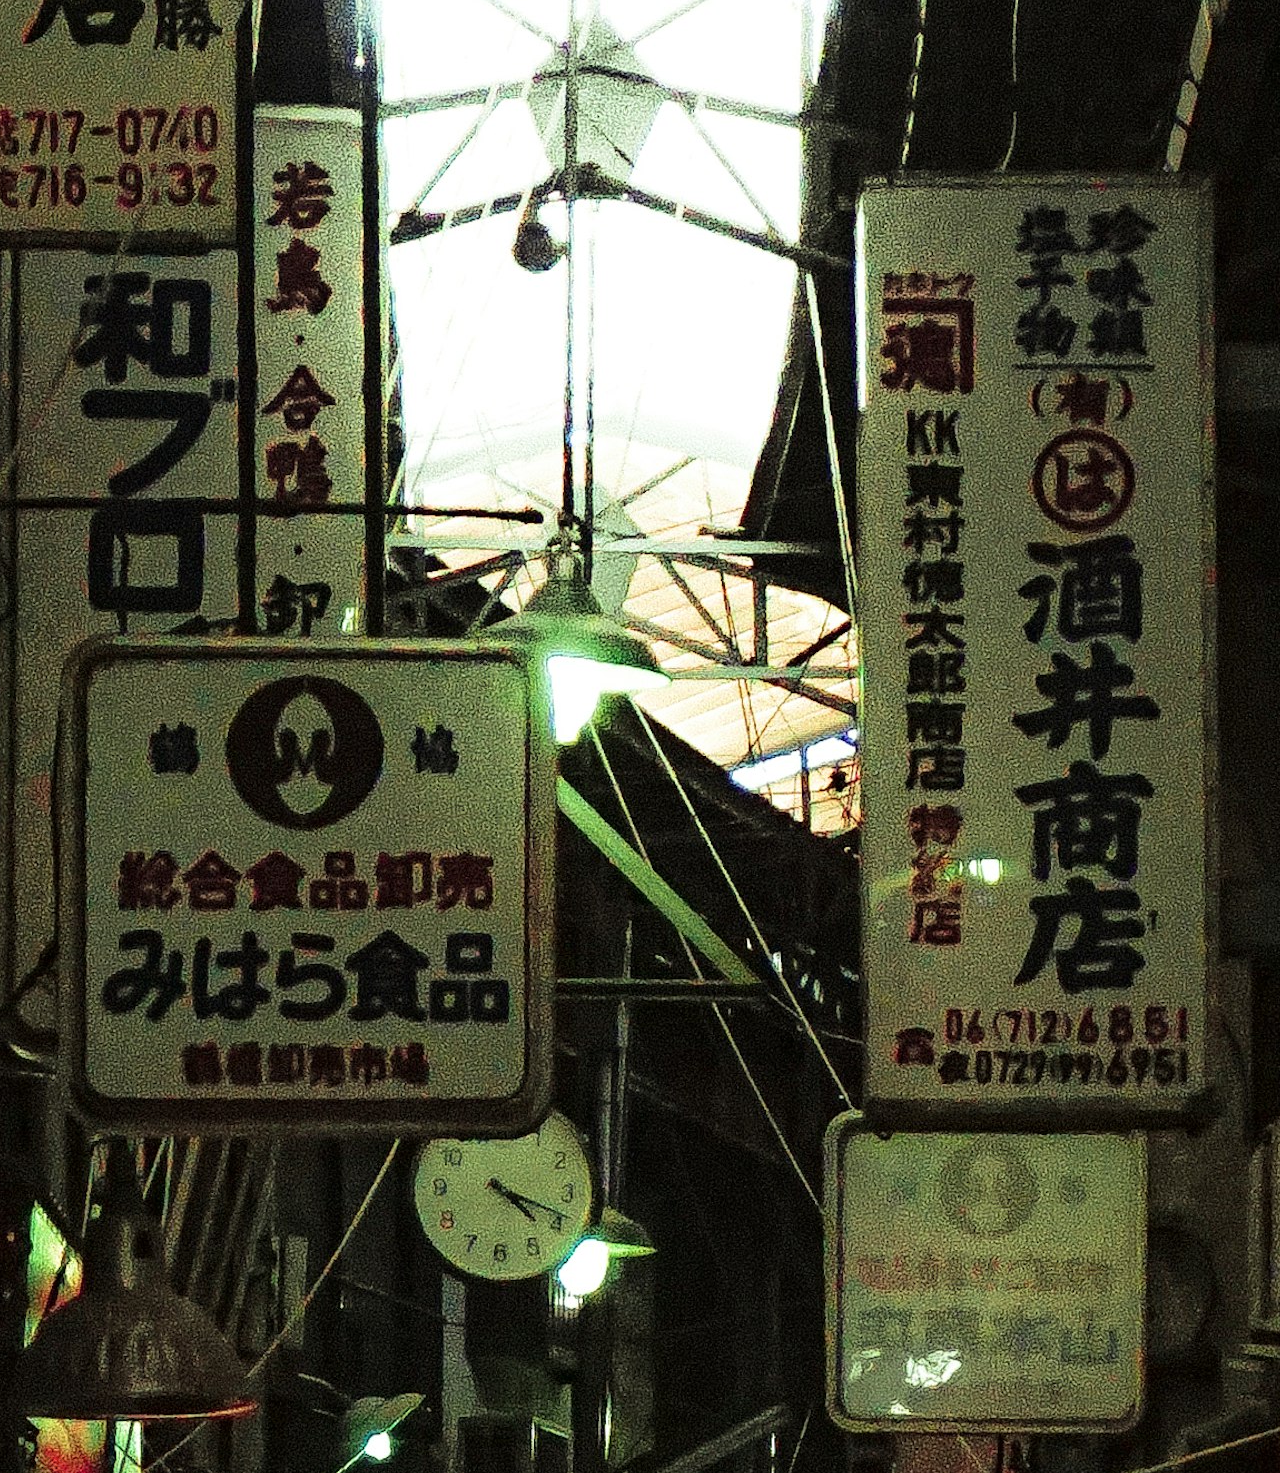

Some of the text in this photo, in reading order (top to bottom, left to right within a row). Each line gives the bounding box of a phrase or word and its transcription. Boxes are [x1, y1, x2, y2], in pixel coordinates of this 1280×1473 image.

[1012, 537, 1161, 996] 酒井商店
[117, 849, 495, 912] 総合食品卸売
[101, 928, 511, 1023] みはら食品
[443, 1148, 463, 1168] 10
[555, 1151, 567, 1169] 2
[432, 1178, 448, 1197] 9
[562, 1182, 575, 1204] 3
[439, 1209, 455, 1230] 8
[464, 1234, 479, 1253] 7
[493, 1243, 508, 1263] 6
